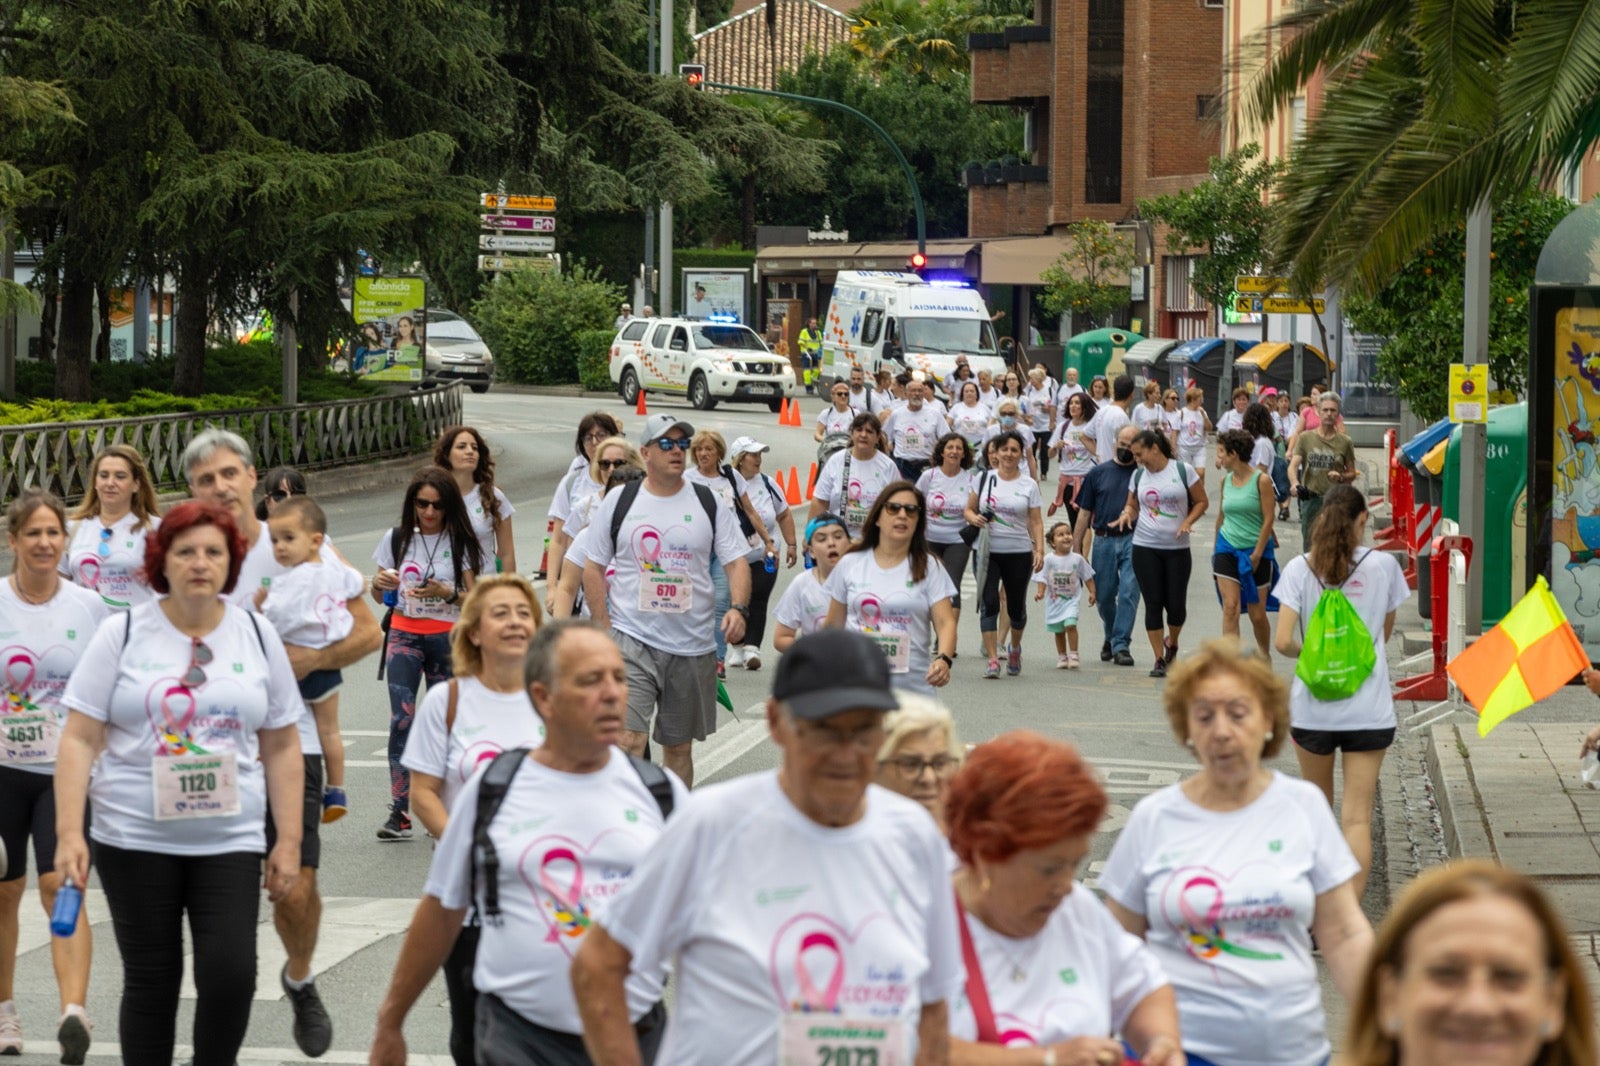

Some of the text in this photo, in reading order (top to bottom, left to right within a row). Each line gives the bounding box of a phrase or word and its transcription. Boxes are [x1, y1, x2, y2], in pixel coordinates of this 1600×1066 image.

[1270, 300, 1298, 308] Puerta
[1309, 453, 1335, 462] GREEN
[656, 584, 677, 597] 670
[7, 725, 44, 743] 4631
[178, 772, 217, 793] 1120
[817, 1044, 879, 1066] 2073
